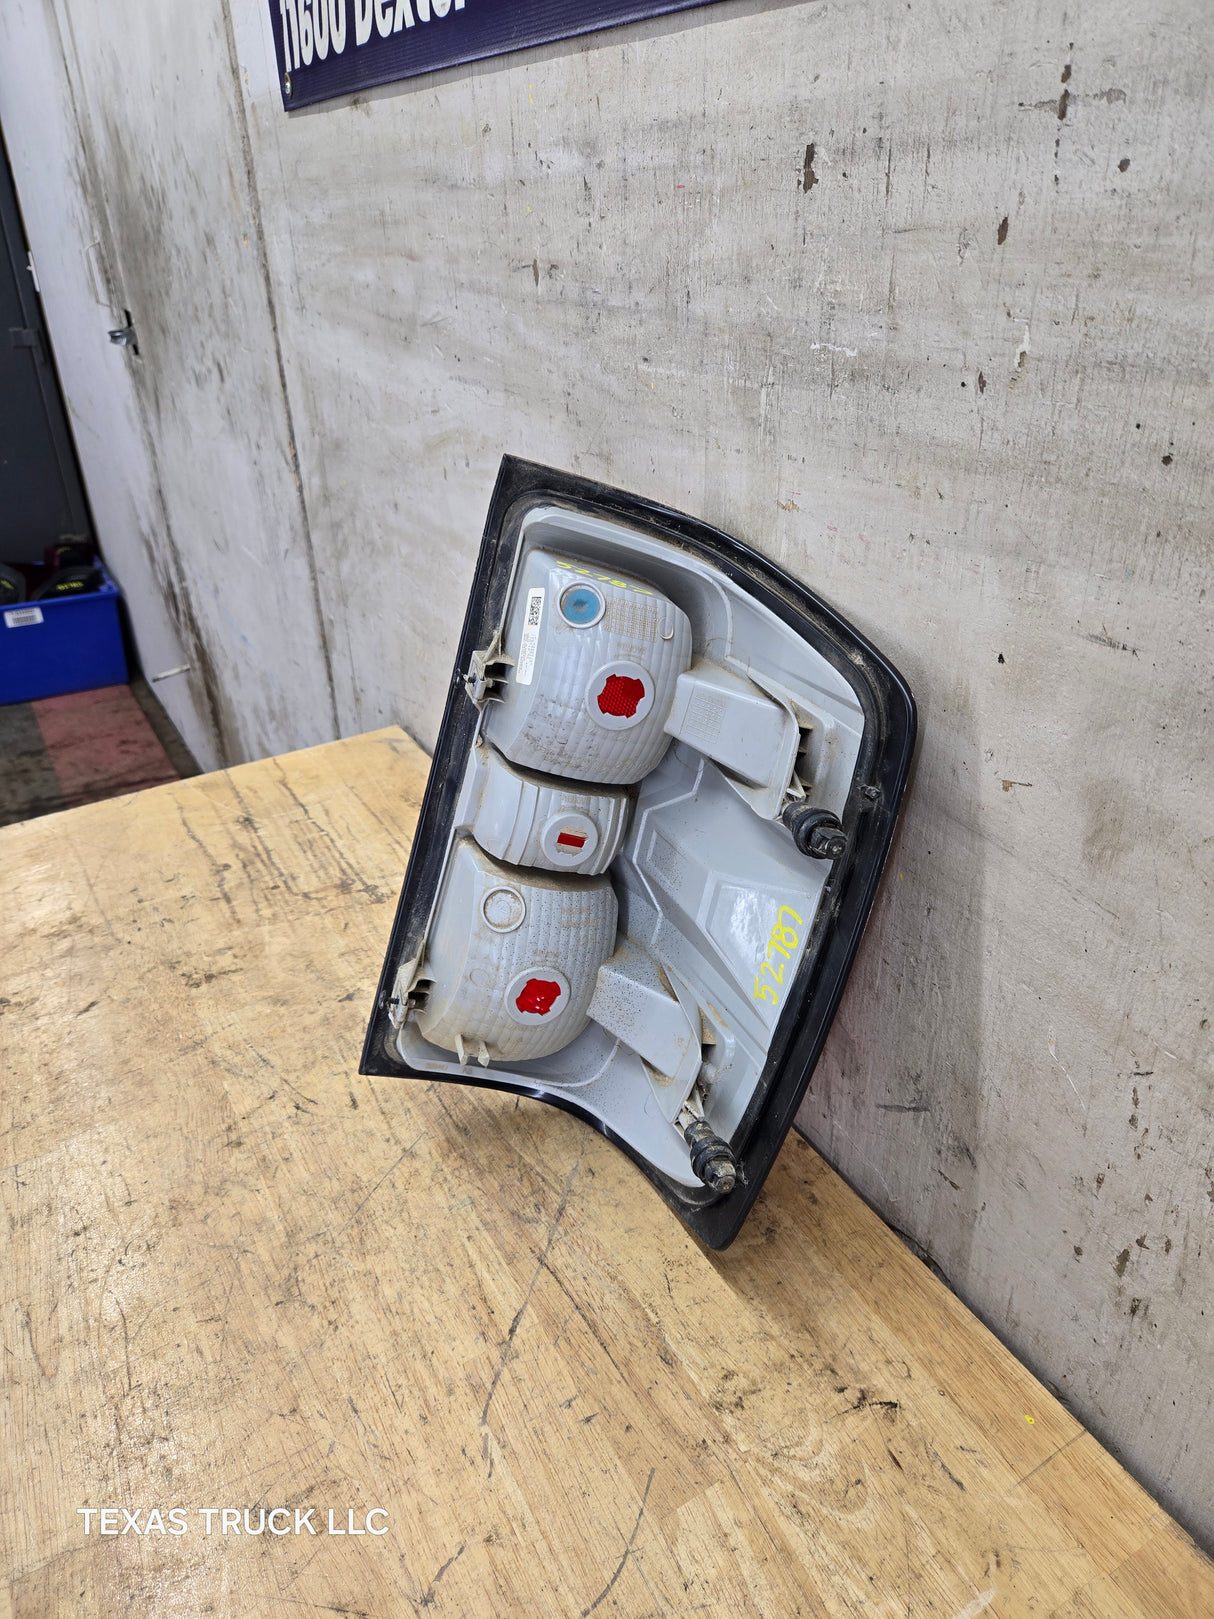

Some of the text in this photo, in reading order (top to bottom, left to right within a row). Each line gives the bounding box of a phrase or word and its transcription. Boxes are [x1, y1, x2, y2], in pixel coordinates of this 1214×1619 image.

[280, 0, 465, 72] 11600 Dex
[753, 904, 803, 1006] 52787
